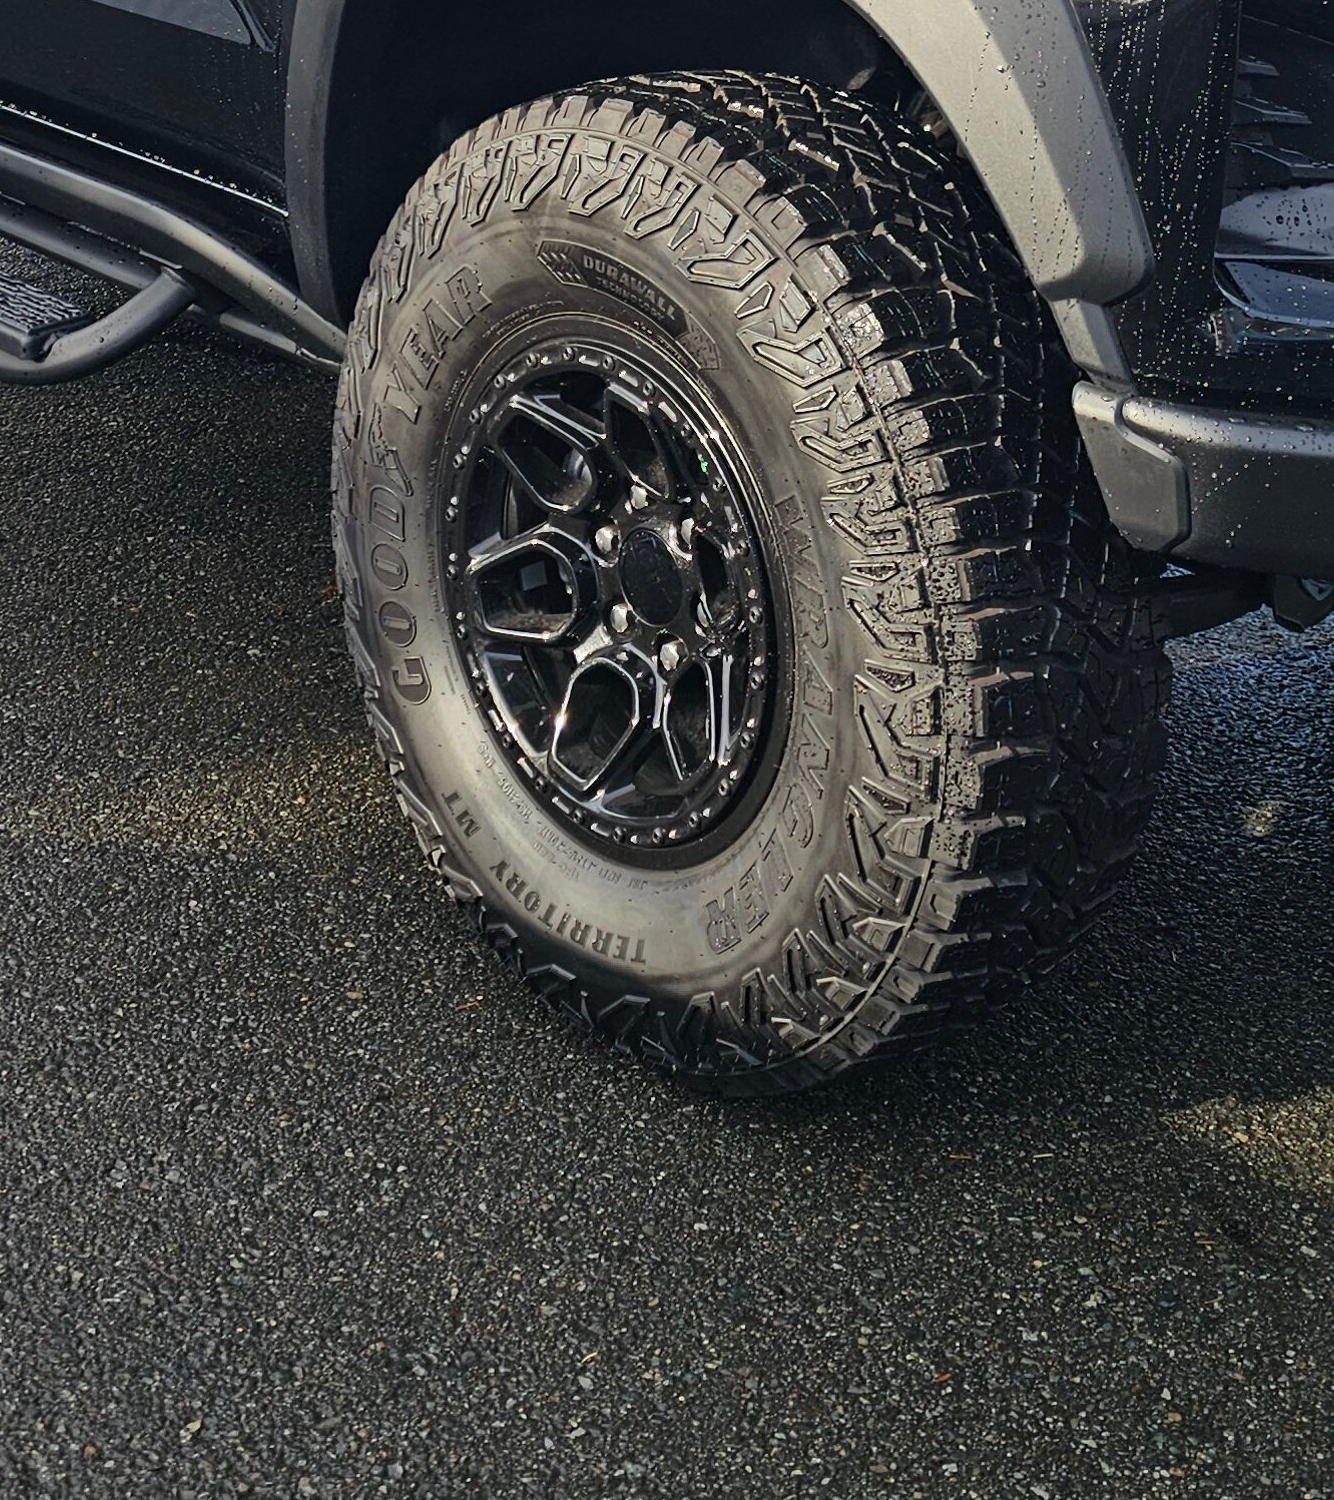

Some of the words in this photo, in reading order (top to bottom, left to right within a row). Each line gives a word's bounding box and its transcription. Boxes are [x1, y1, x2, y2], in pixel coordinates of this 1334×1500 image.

[582, 254, 677, 321] DURAWALL
[707, 494, 834, 956] WRANGLER
[441, 790, 482, 838] MT
[489, 858, 648, 965] TERRITORY
